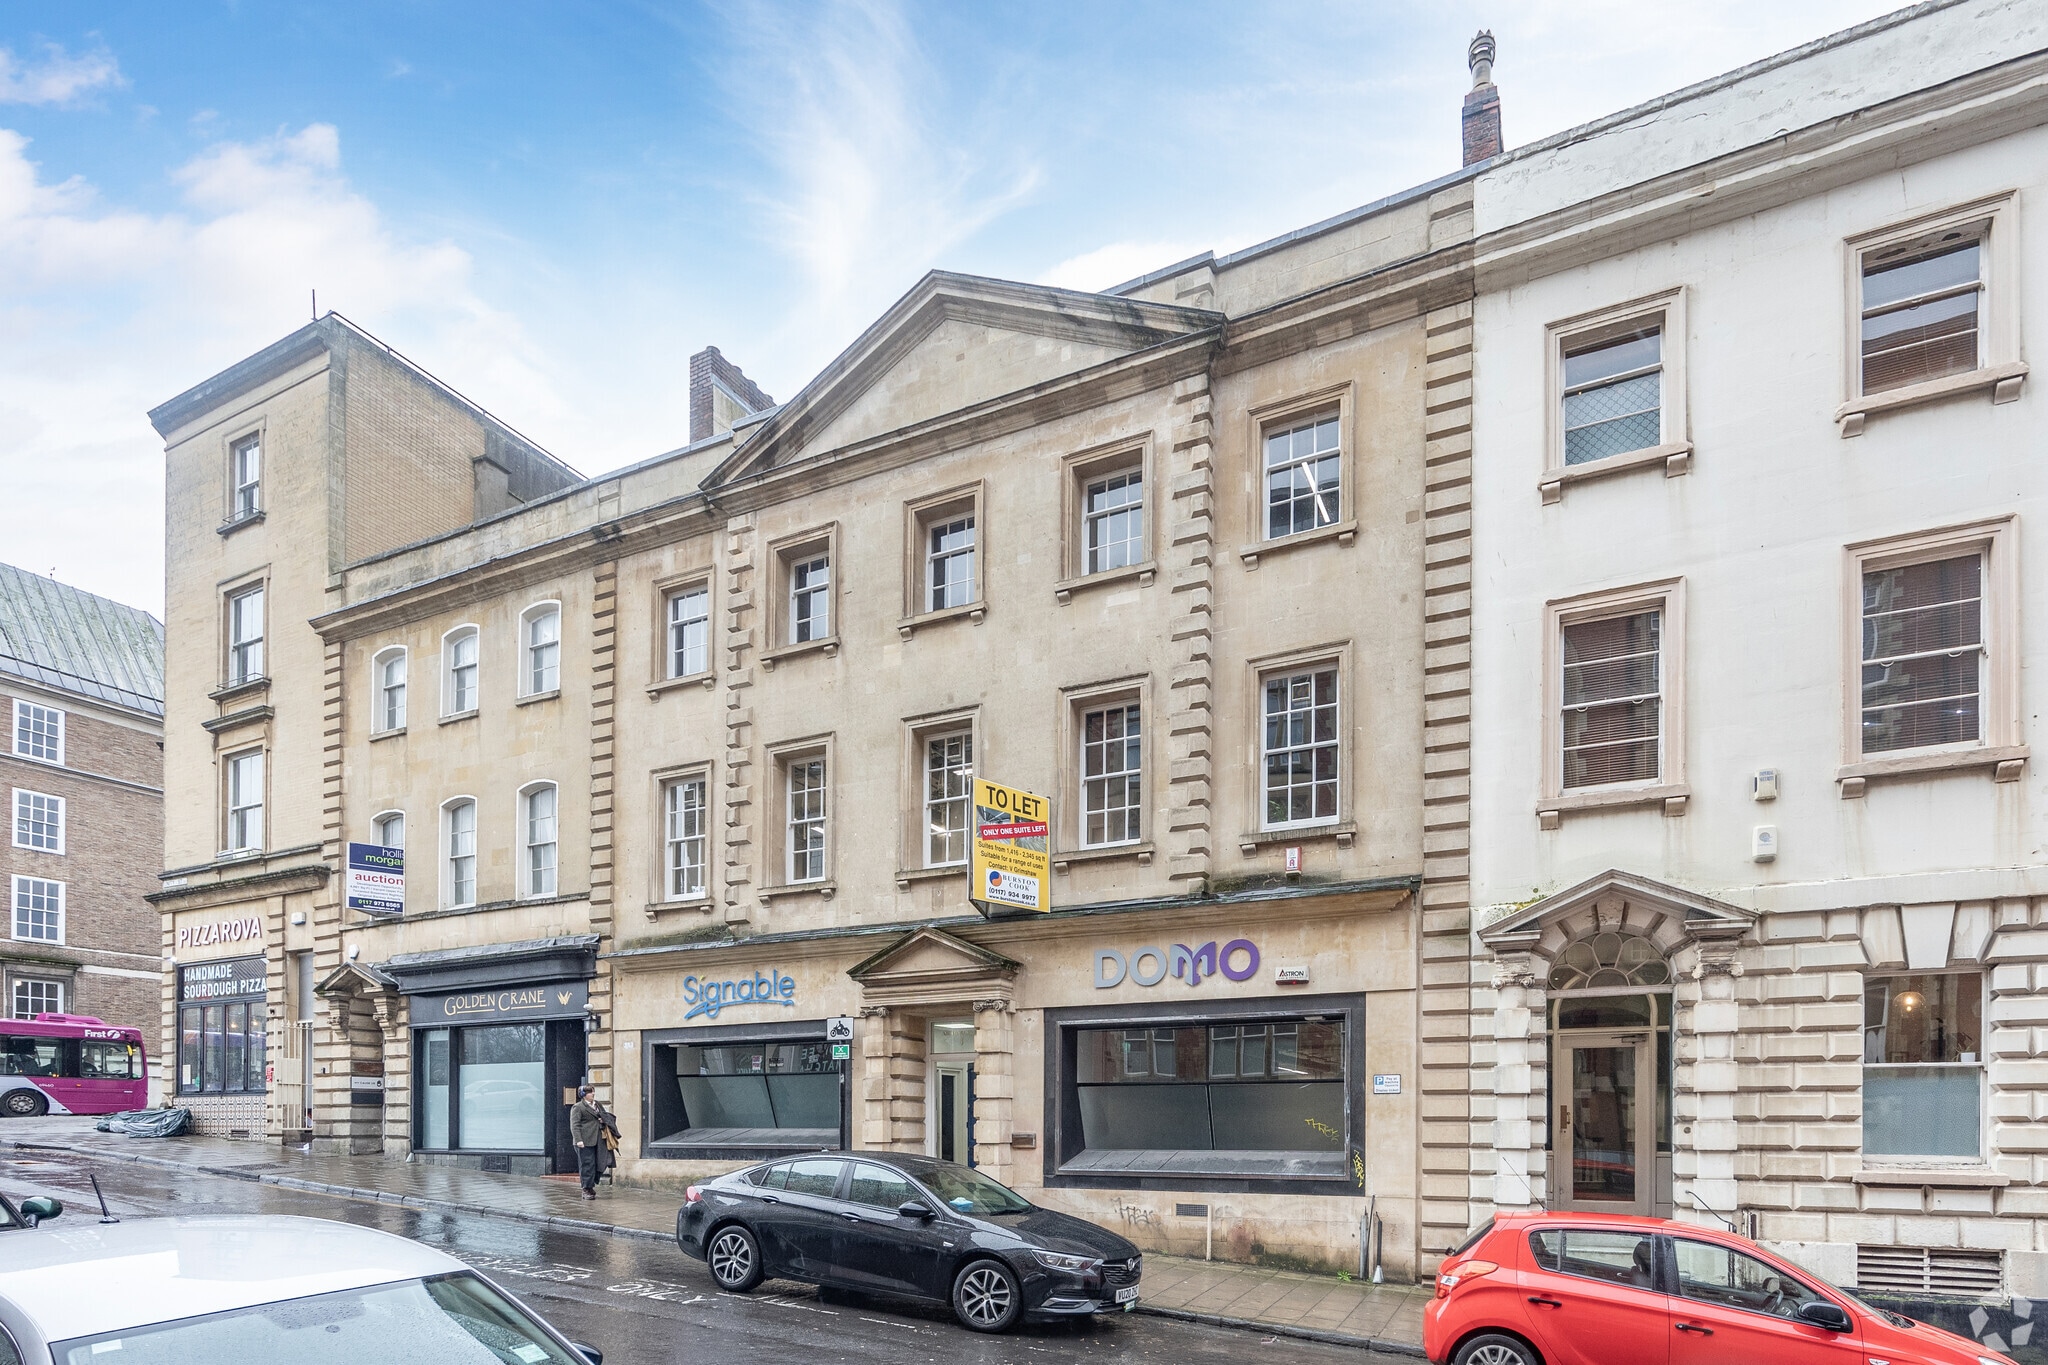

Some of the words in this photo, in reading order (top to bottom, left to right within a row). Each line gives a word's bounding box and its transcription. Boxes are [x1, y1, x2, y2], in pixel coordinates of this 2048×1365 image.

[986, 785, 1007, 809] TO
[1012, 793, 1041, 817] LET
[983, 828, 999, 836] ONLY
[1000, 827, 1013, 835] ONE
[1014, 826, 1031, 834] SUITE
[978, 840, 994, 850] Suites
[995, 845, 1006, 853] from
[980, 850, 1000, 860] Suitable
[1012, 858, 1026, 867] range
[988, 861, 1008, 871] Contact:
[1014, 866, 1037, 877] Grimshaw
[355, 873, 404, 885] auction
[1002, 874, 1036, 886] BURSTON
[1008, 882, 1030, 891] COOK
[988, 886, 1006, 896] (0117)
[1021, 893, 1036, 901] 9977
[179, 916, 262, 948] PIZZAROVA
[1094, 938, 1261, 989] DOMO
[184, 964, 232, 981] HANDMADE
[1279, 969, 1304, 977] ASTRON
[184, 980, 238, 999] SOURDOUGH
[240, 978, 267, 993] PIZZA
[683, 968, 796, 1020] Signable
[444, 993, 496, 1016] GOLDEN
[498, 989, 546, 1011] CRANE
[84, 1029, 106, 1038] First
